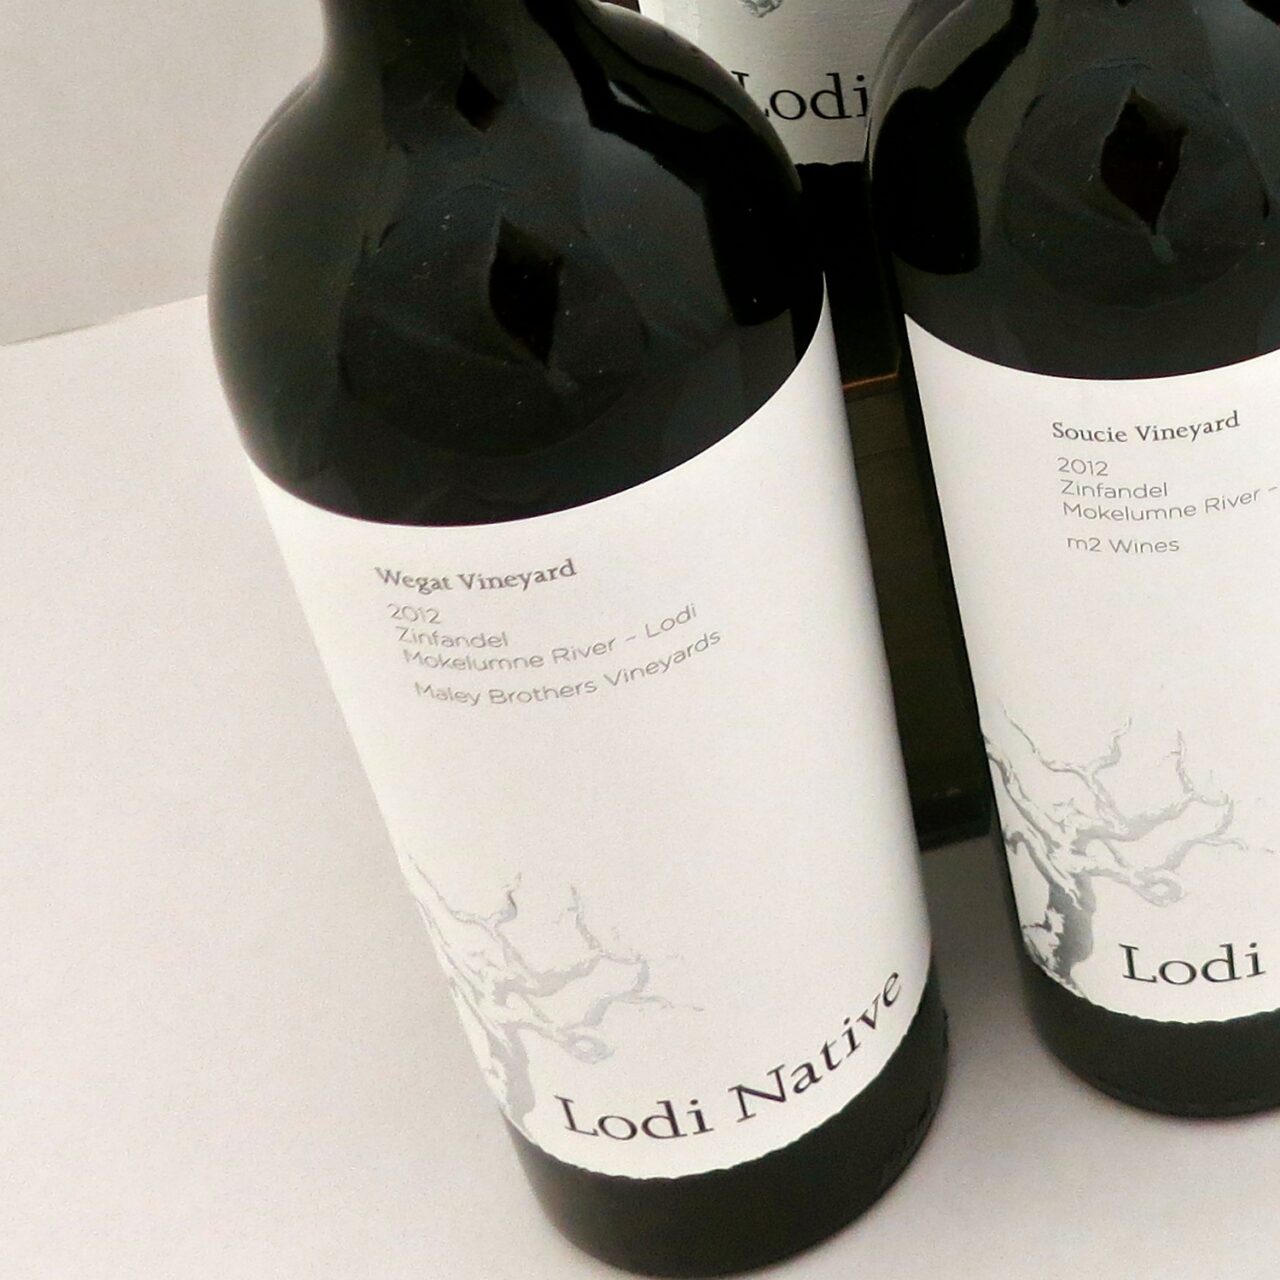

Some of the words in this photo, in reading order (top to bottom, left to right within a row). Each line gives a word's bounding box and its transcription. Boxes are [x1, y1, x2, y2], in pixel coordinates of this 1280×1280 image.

[1052, 422, 1128, 443] Soucie
[1135, 409, 1240, 444] Vineyard
[1057, 457, 1109, 477] 2012
[1060, 479, 1168, 500] Zinfandel
[1063, 502, 1197, 522] Mokelumne
[1205, 488, 1261, 514] River
[1067, 537, 1101, 552] m2
[1110, 538, 1180, 554] Wines
[374, 567, 453, 596] Wegat
[457, 558, 577, 591] Vineyard
[386, 603, 441, 625] 2012
[395, 626, 508, 649] Zinfandel
[402, 648, 545, 672] Mokelumne
[552, 636, 617, 664] River
[645, 603, 697, 639] Lodi
[414, 681, 480, 707] Maley
[488, 679, 598, 705] Brothers
[603, 629, 722, 687] Vineyards
[1118, 942, 1266, 985] Lodi
[553, 1094, 715, 1141] Lodi
[727, 971, 902, 1123] Native
